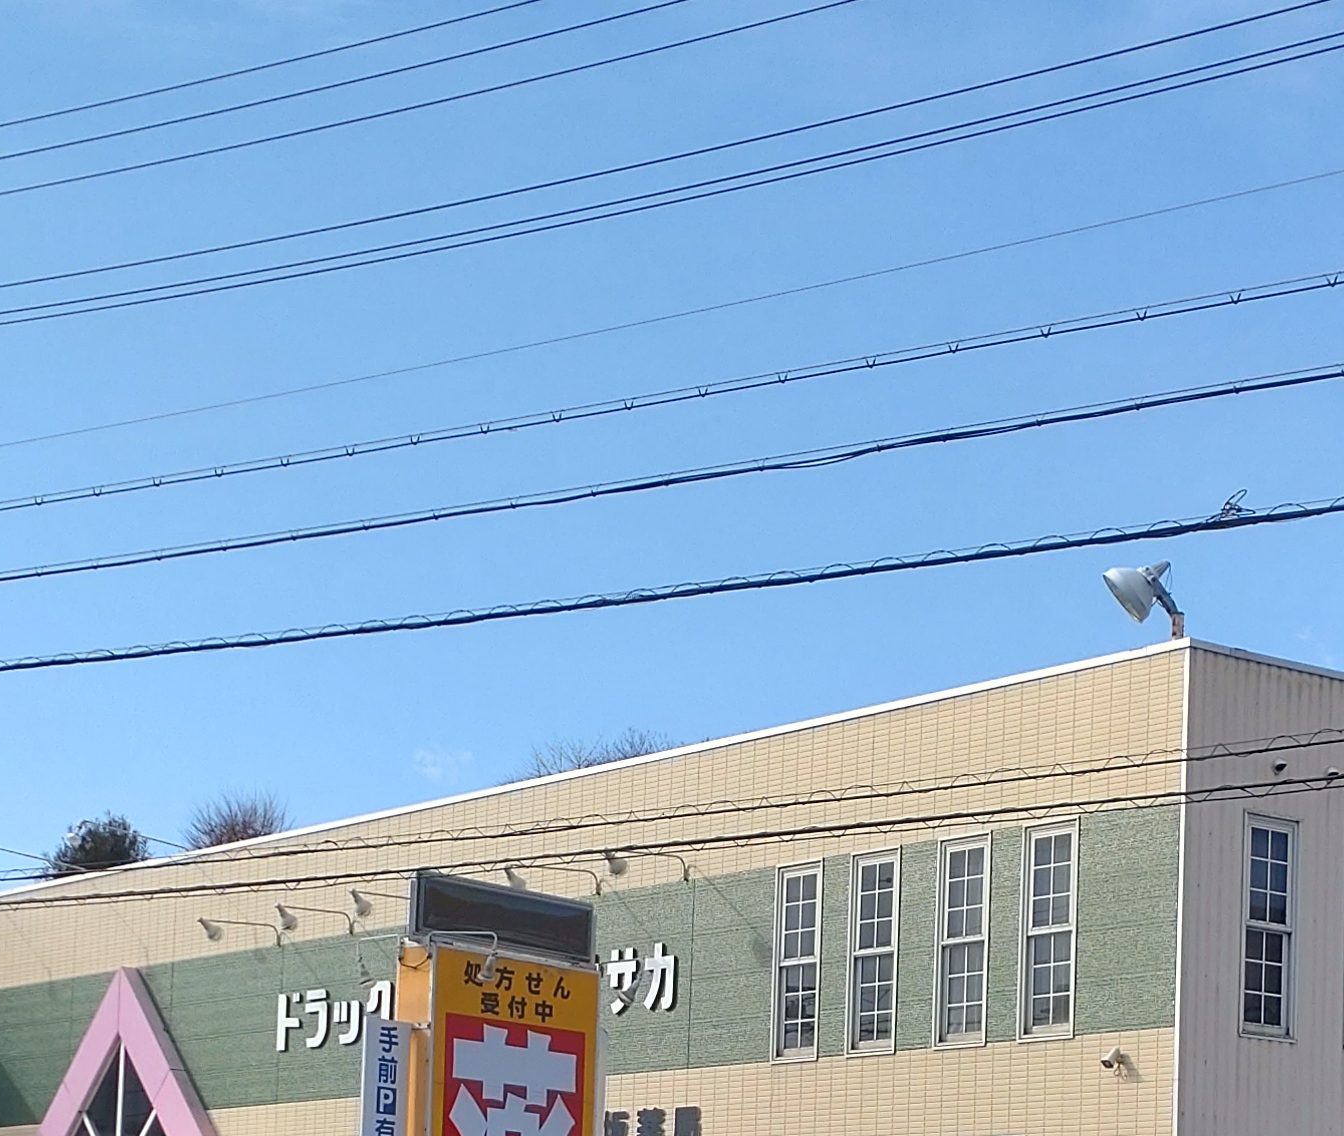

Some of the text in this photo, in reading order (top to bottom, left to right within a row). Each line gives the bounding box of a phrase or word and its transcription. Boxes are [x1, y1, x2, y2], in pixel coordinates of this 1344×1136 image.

[463, 960, 571, 1000] 処方せん
[480, 991, 554, 1023] 受付中
